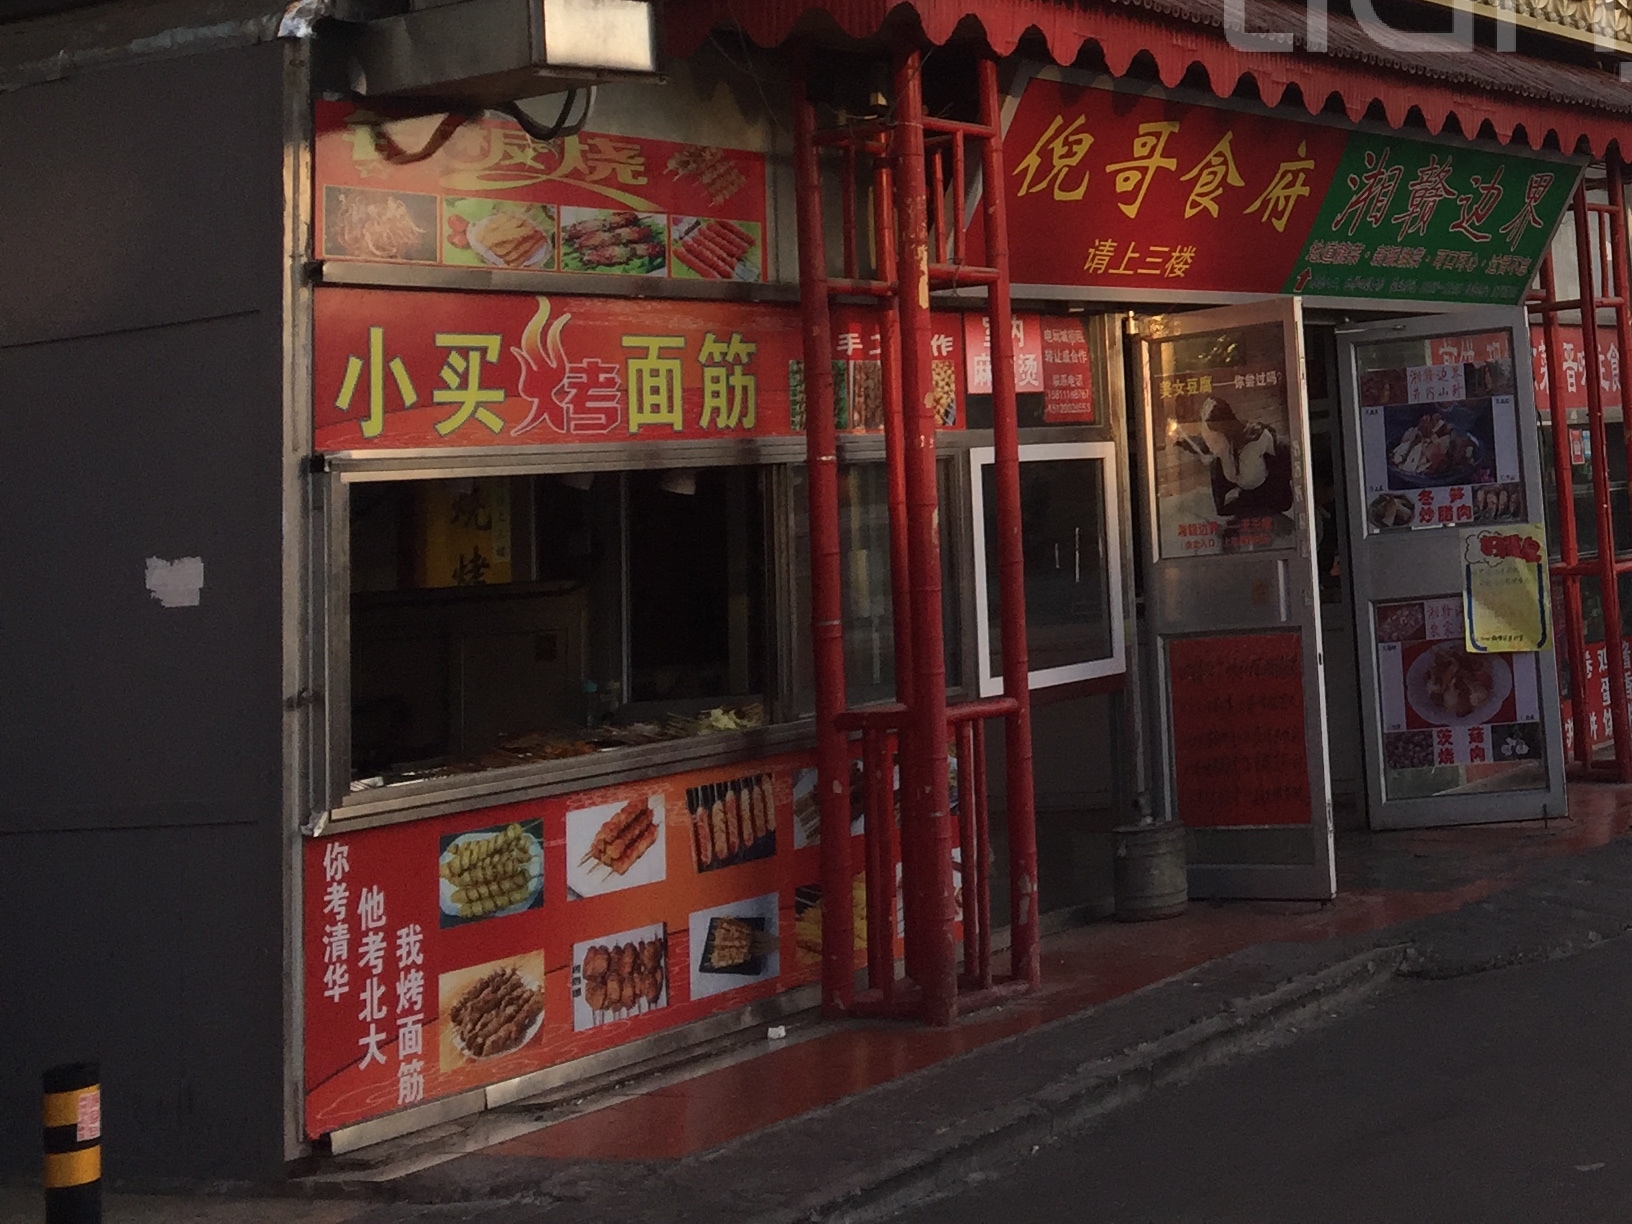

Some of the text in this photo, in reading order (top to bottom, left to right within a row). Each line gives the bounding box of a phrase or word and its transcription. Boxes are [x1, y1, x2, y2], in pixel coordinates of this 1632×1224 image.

[1012, 113, 1315, 233] 倪哥食府
[1083, 238, 1197, 278] 请上三楼
[973, 353, 1040, 387] 麻烫
[323, 842, 350, 1003] 你考清华
[357, 886, 388, 1070] 他考北大
[395, 923, 425, 1105] 我烤面筋
